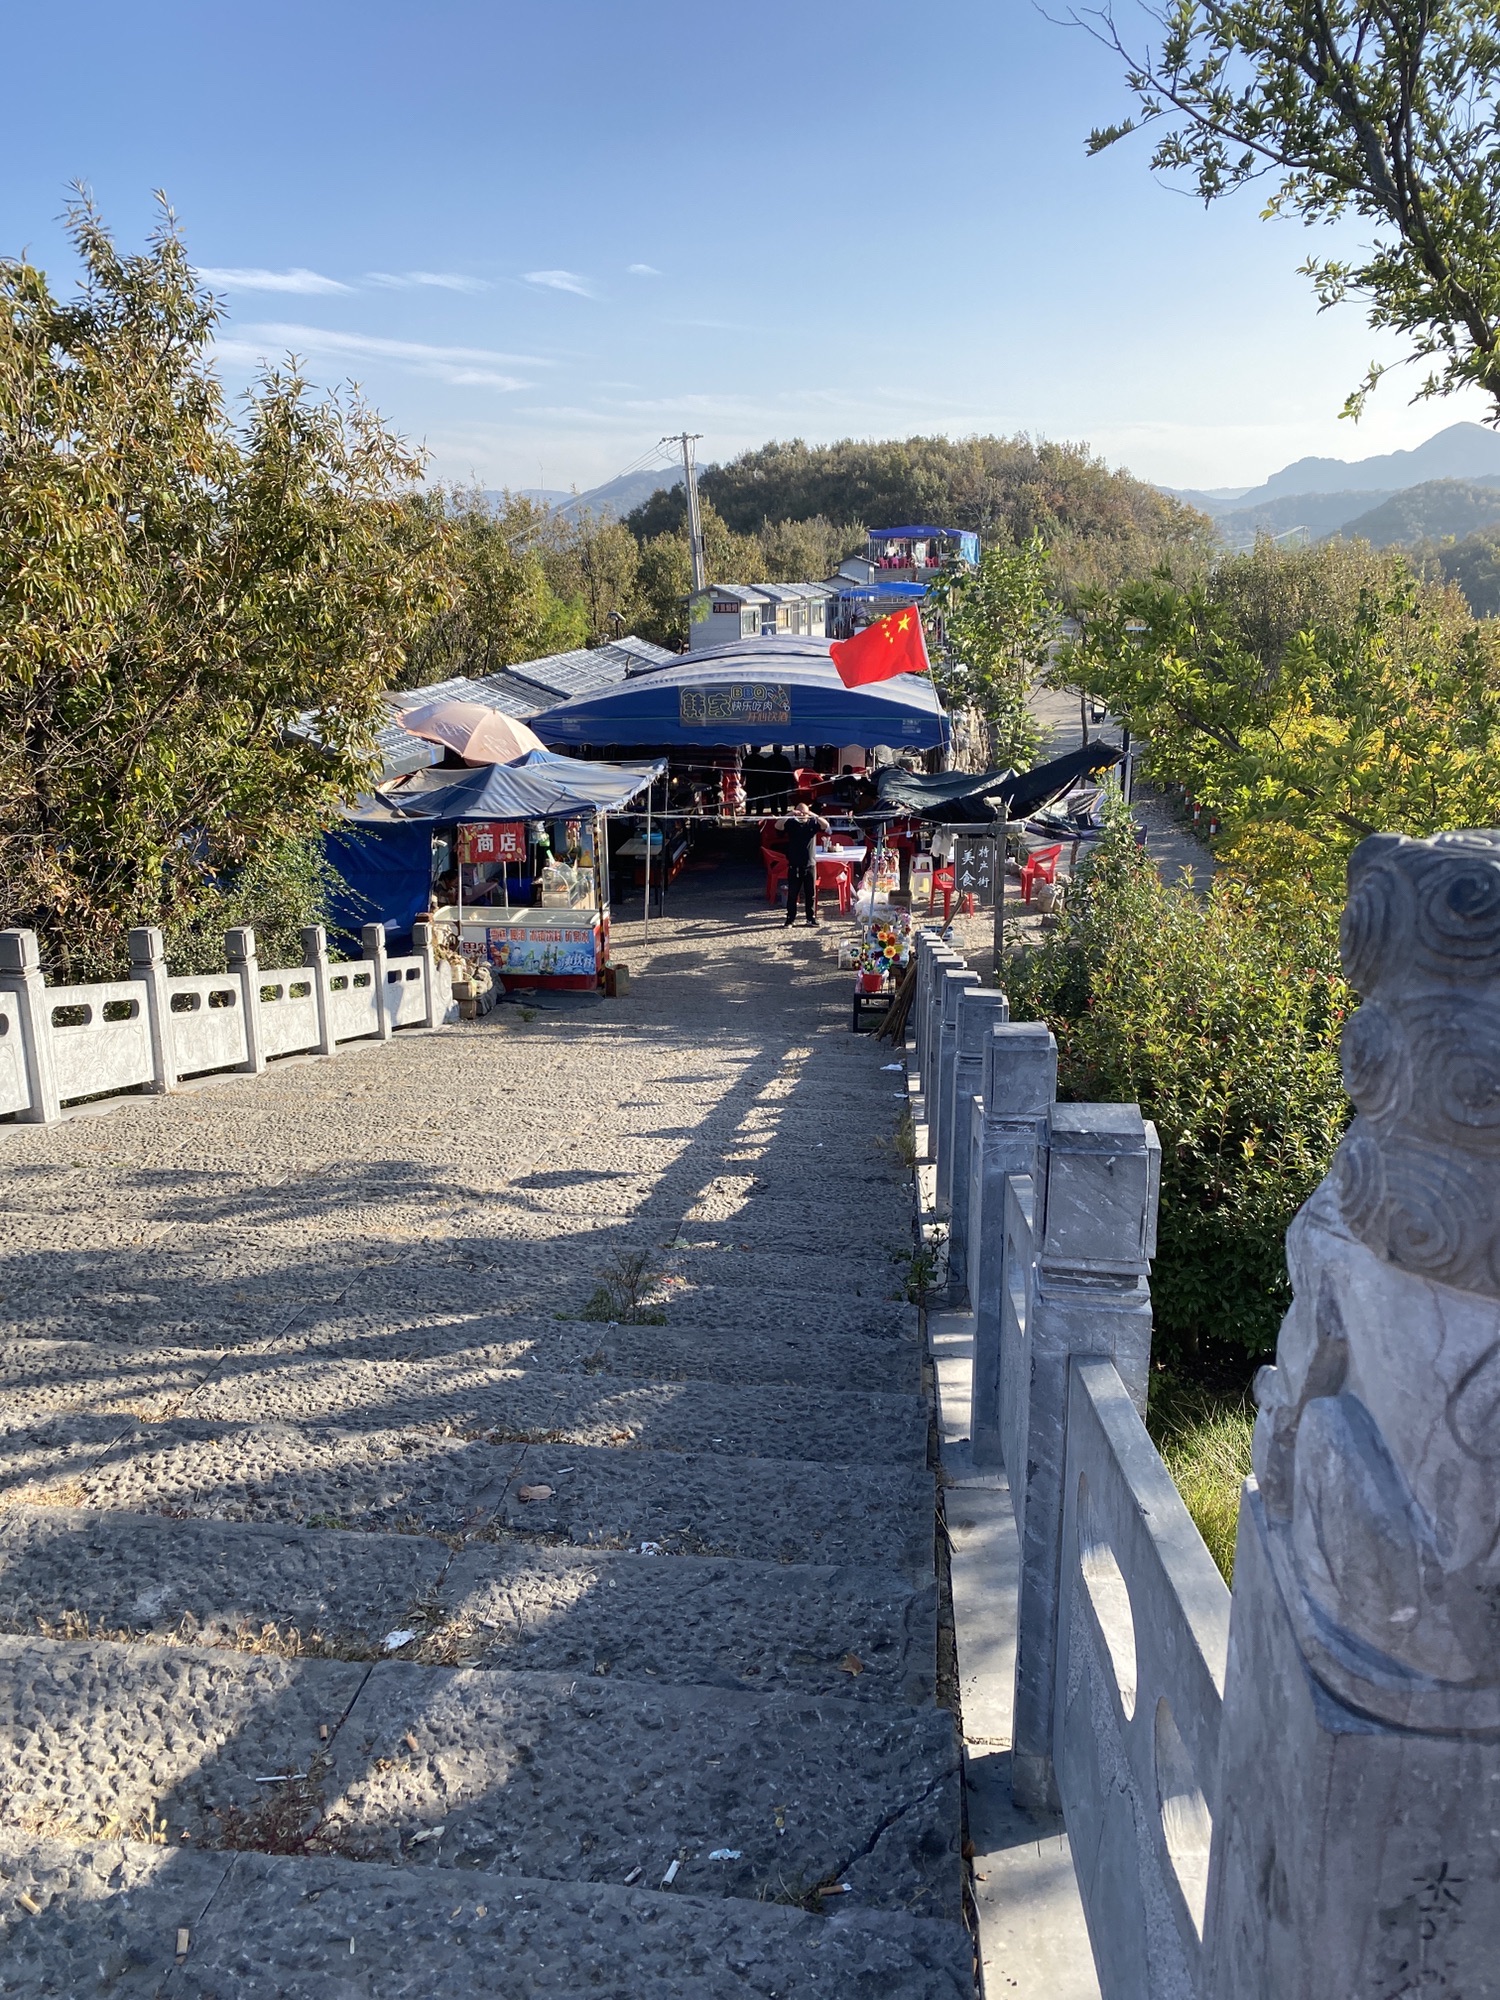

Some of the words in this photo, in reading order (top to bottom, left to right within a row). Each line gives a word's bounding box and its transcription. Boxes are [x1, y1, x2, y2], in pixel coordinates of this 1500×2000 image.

[732, 685, 767, 700] BBQ
[683, 693, 732, 717] 韩家
[732, 701, 773, 712] 快乐吃肉
[747, 712, 788, 722] 开心饮酒
[477, 833, 516, 852] 商店
[959, 848, 976, 887] 美食
[977, 845, 990, 888] 特产街
